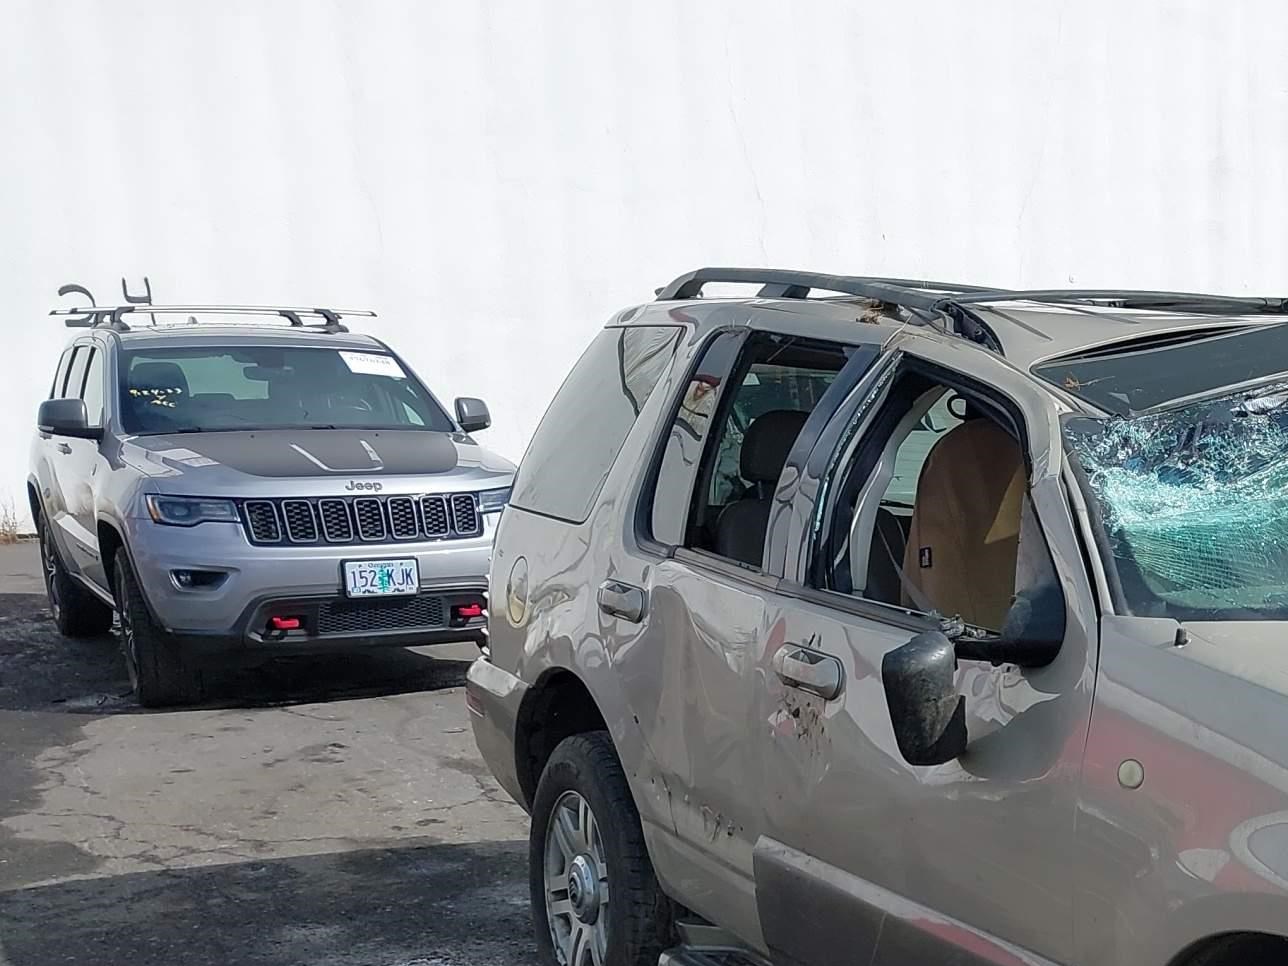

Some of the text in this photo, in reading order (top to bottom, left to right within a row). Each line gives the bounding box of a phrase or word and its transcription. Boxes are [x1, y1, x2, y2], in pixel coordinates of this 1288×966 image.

[345, 481, 383, 492] Jeep
[351, 568, 415, 589] 152 KJK
